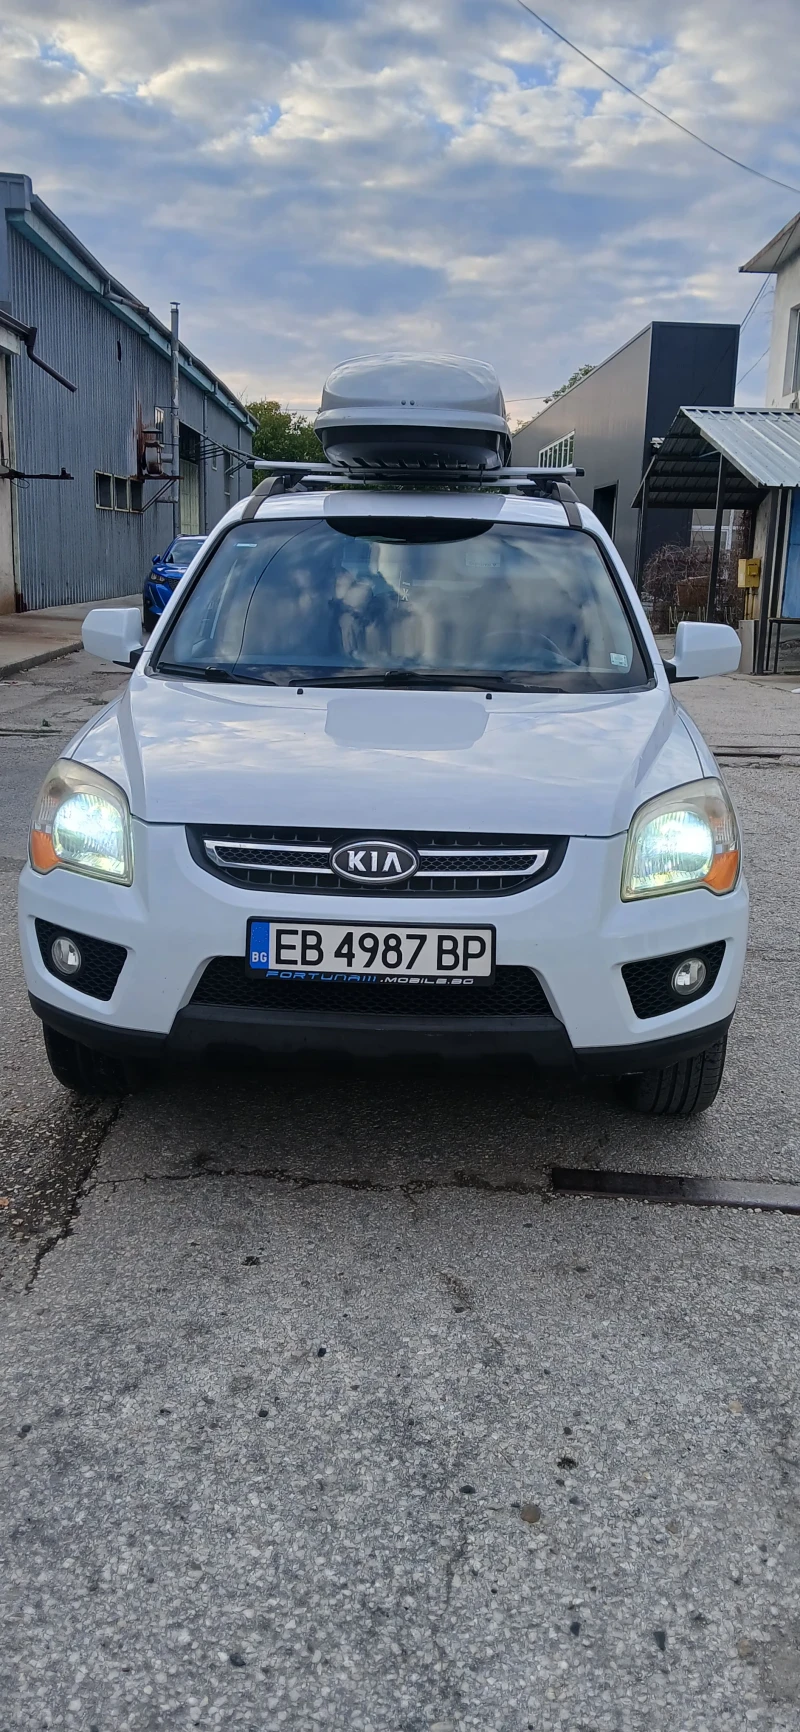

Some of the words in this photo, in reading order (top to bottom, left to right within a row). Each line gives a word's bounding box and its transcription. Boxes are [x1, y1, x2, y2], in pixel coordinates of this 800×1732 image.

[347, 850, 402, 873] KIA
[251, 951, 268, 963] BG
[275, 928, 324, 966] EB
[334, 931, 428, 970] 4987
[436, 934, 487, 971] BP
